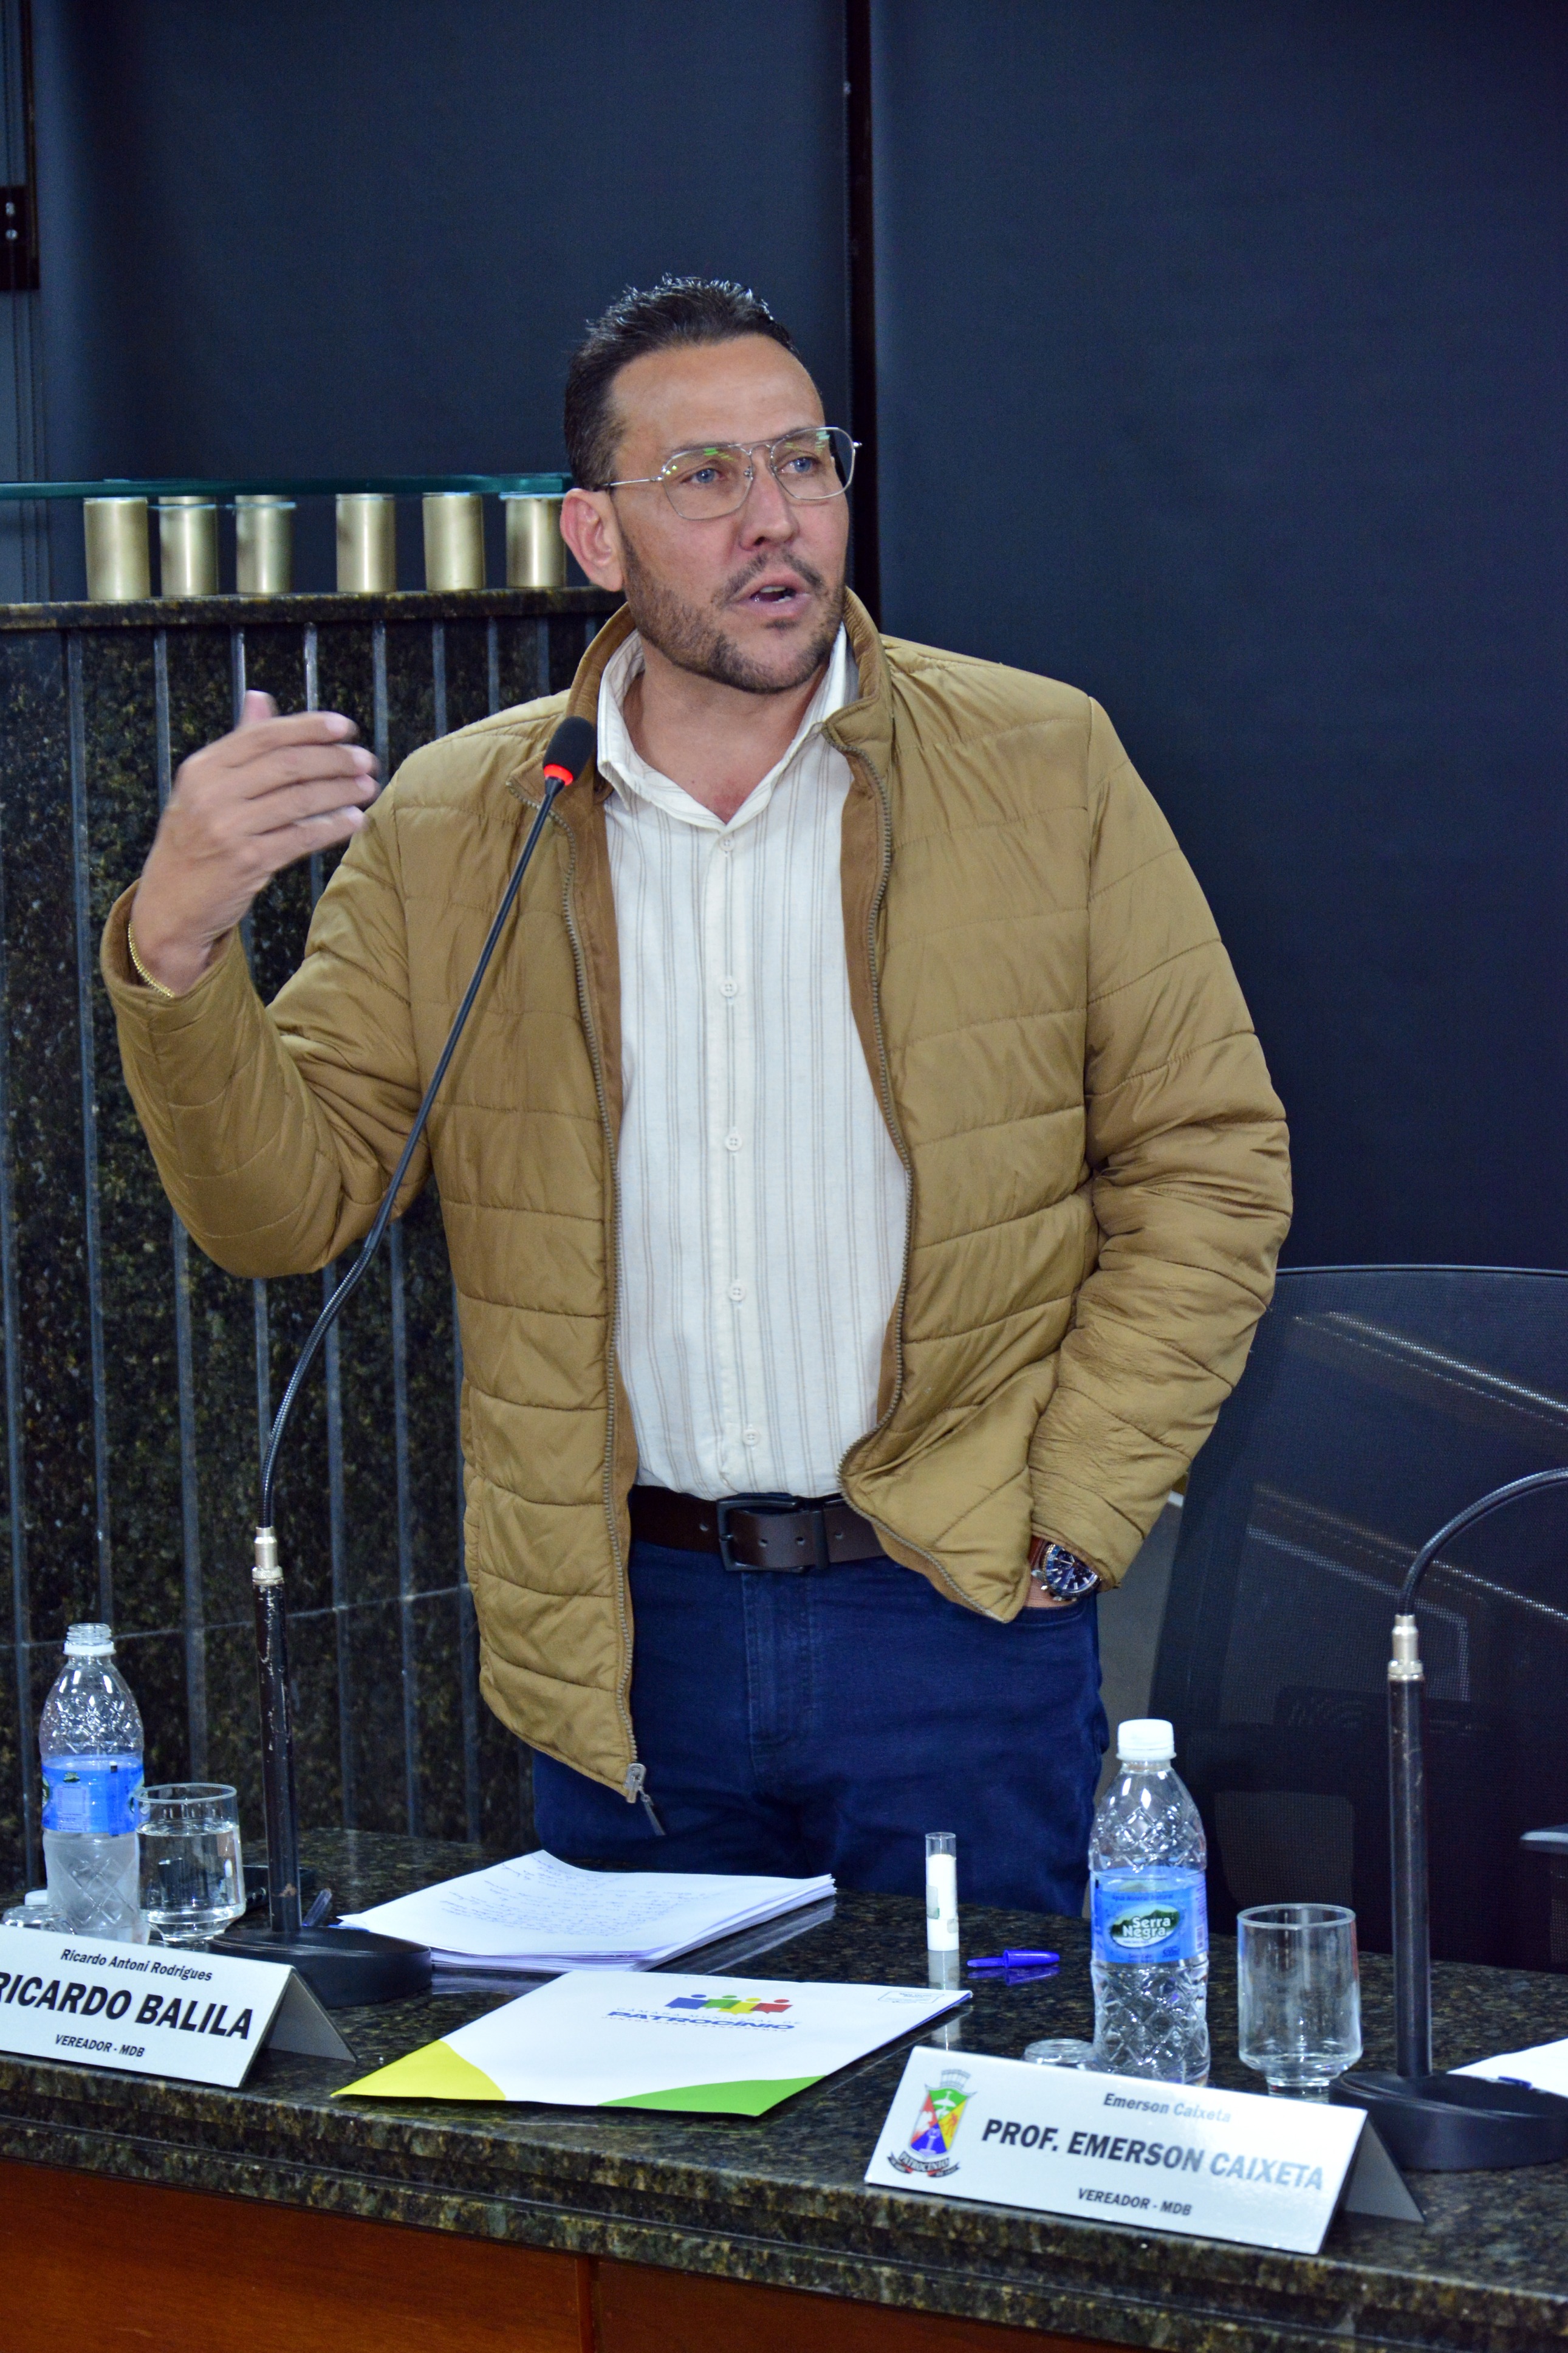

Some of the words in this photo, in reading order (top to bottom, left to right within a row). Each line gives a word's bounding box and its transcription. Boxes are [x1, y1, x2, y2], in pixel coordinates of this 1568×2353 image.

[1122, 1925, 1166, 1940] Negra
[1132, 1917, 1171, 1928] Serra
[60, 1948, 107, 1966] Ricardo
[108, 1956, 151, 1973] Antoni
[150, 1962, 213, 1981] Rodrigues
[134, 1993, 253, 2040] BALILA
[607, 2011, 795, 2030] PATROCÍNIO
[55, 2034, 113, 2053] VEREADOR
[118, 2044, 145, 2058] MDB
[1103, 2093, 1169, 2114] Emerson
[1173, 2103, 1231, 2123] Caixeta
[981, 2119, 1058, 2152] PROF.
[1067, 2131, 1205, 2173] EMERSON
[1209, 2152, 1323, 2190] CAIXETA
[1078, 2187, 1150, 2210] VEREADOR
[1160, 2200, 1193, 2216] MDB
